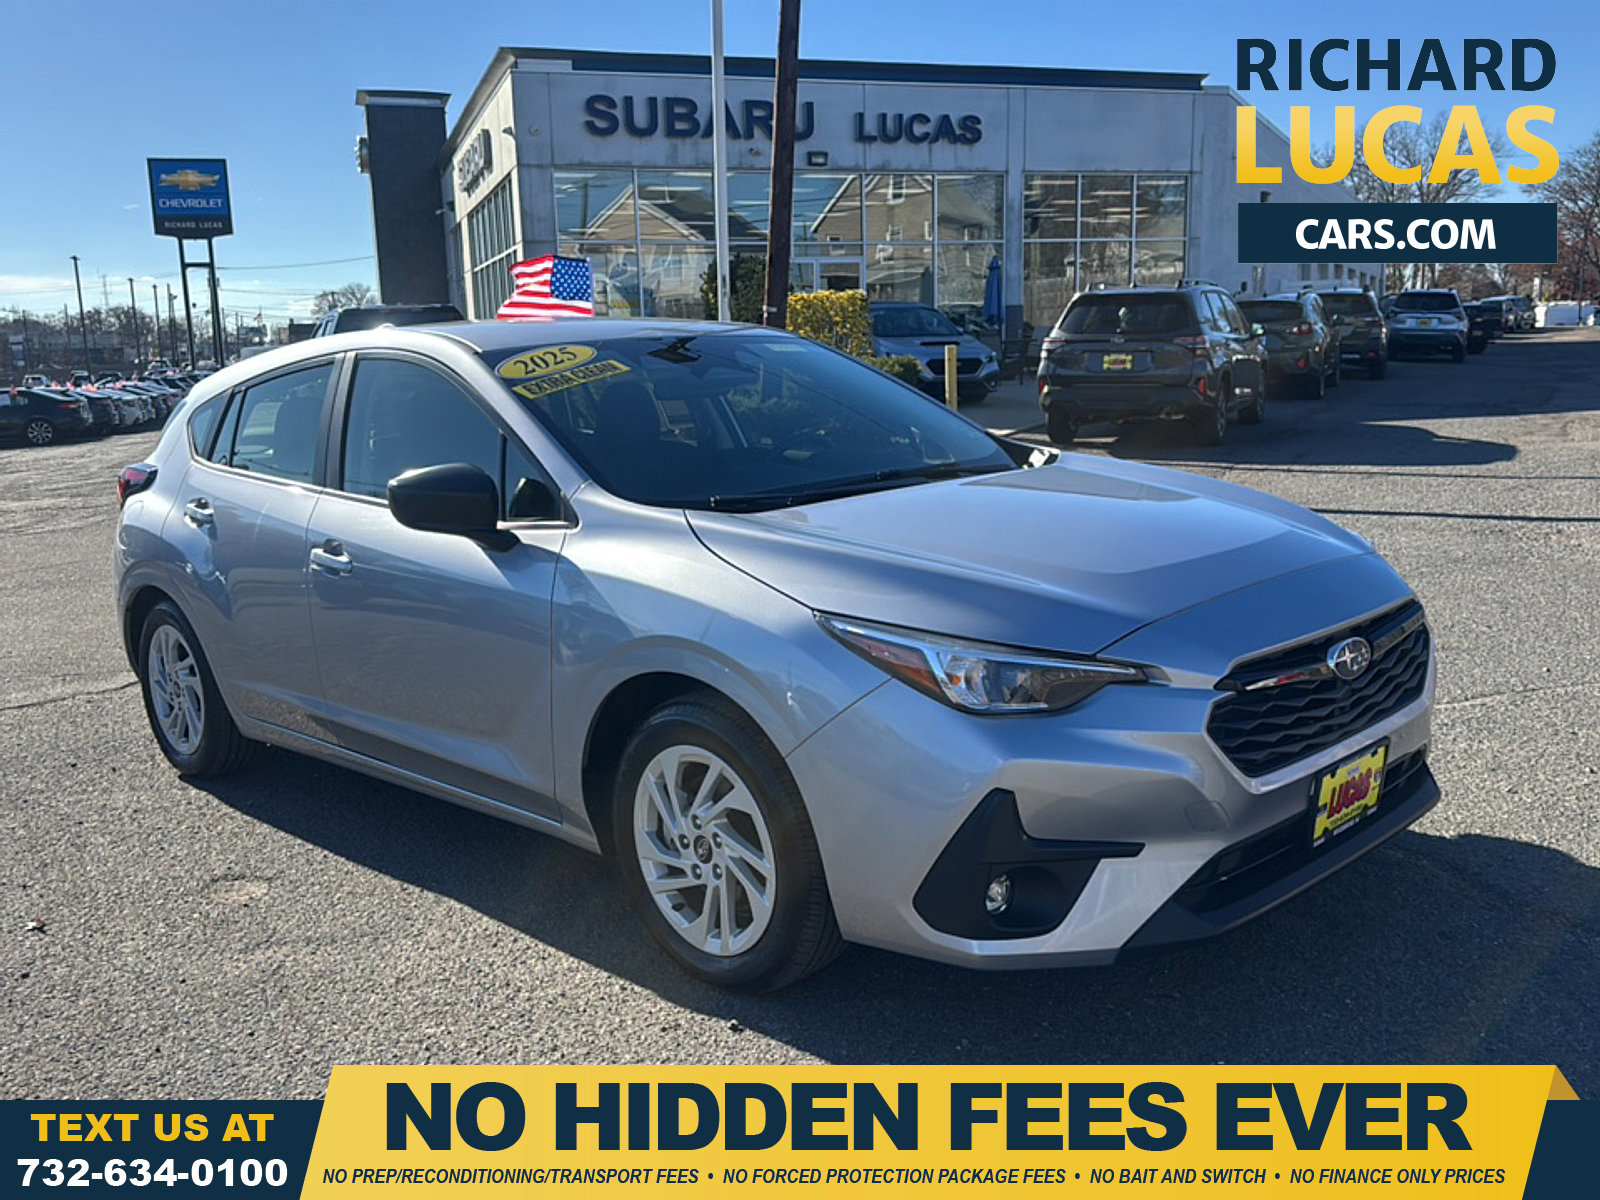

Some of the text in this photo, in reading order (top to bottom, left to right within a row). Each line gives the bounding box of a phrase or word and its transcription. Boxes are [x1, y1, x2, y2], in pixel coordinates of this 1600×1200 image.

[854, 111, 983, 145] LUCAS
[158, 198, 223, 209] CHEVROLET
[164, 221, 223, 229] RICHARD LUCAS
[513, 346, 577, 375] 2025
[1327, 767, 1372, 819] LUCAS
